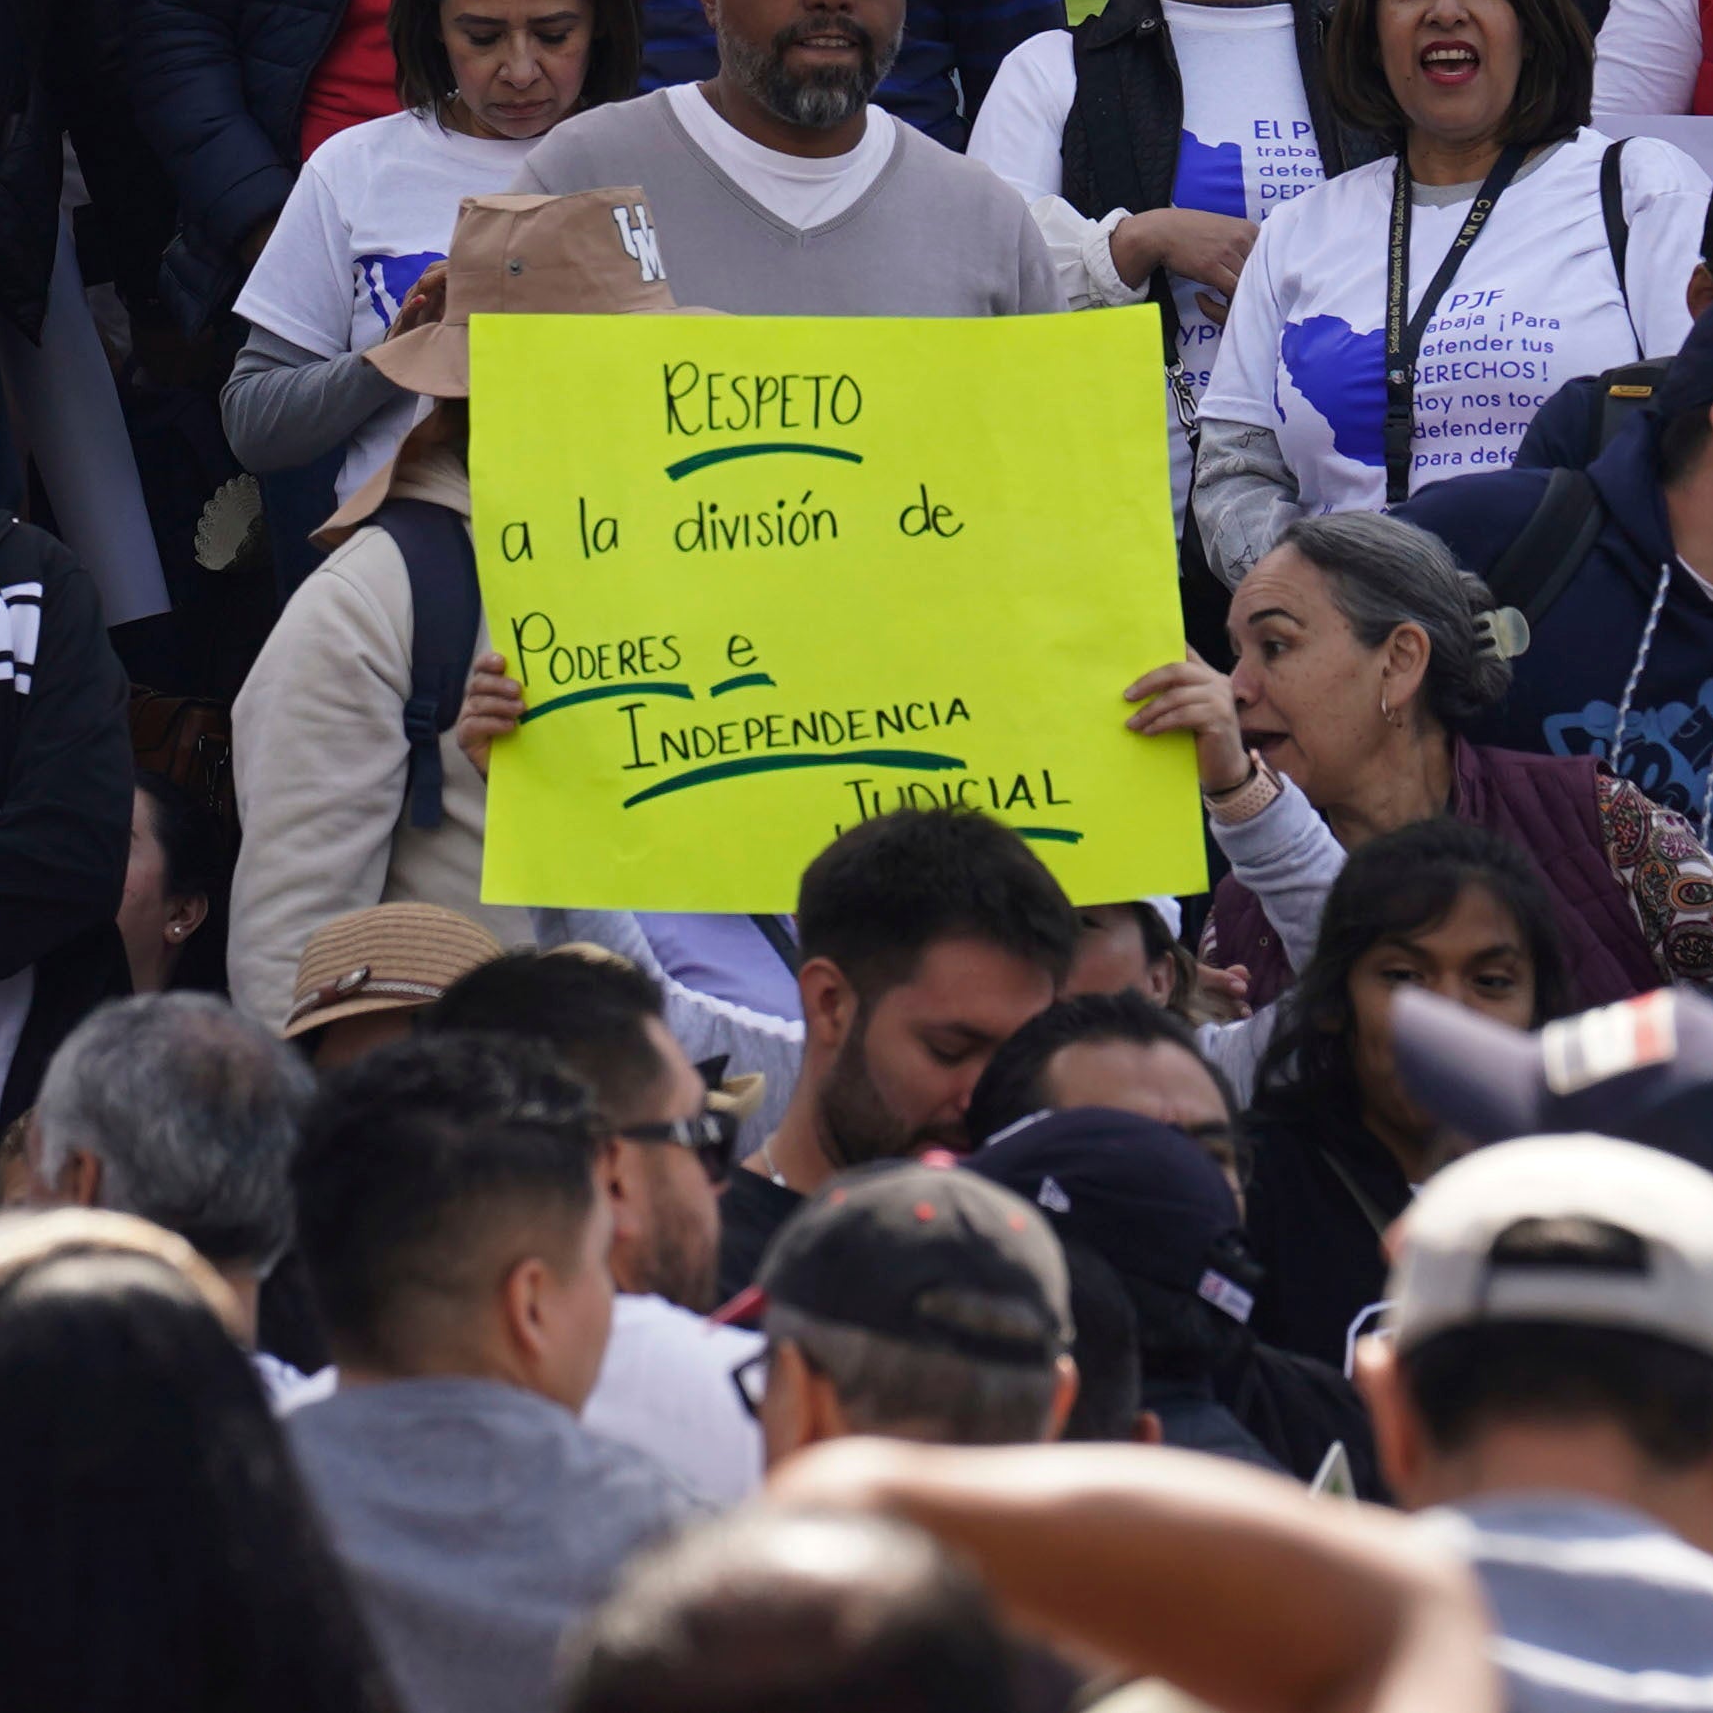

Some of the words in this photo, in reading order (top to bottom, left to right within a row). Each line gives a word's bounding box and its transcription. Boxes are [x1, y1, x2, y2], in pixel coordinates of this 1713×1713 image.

[1253, 120, 1282, 139] El
[1454, 198, 1493, 247] CDMX
[1449, 289, 1505, 314] PJF
[1425, 311, 1486, 335] abaja
[1521, 337, 1554, 355] tus
[663, 361, 863, 436] RESPETO
[1461, 392, 1502, 409] nos
[1414, 448, 1462, 471] para
[501, 520, 533, 561] a
[579, 497, 618, 559] la
[675, 490, 837, 552] división
[898, 483, 964, 538] de
[511, 611, 681, 687] PODERES
[727, 633, 758, 668] e
[620, 697, 971, 771] INDEPENDENCIA
